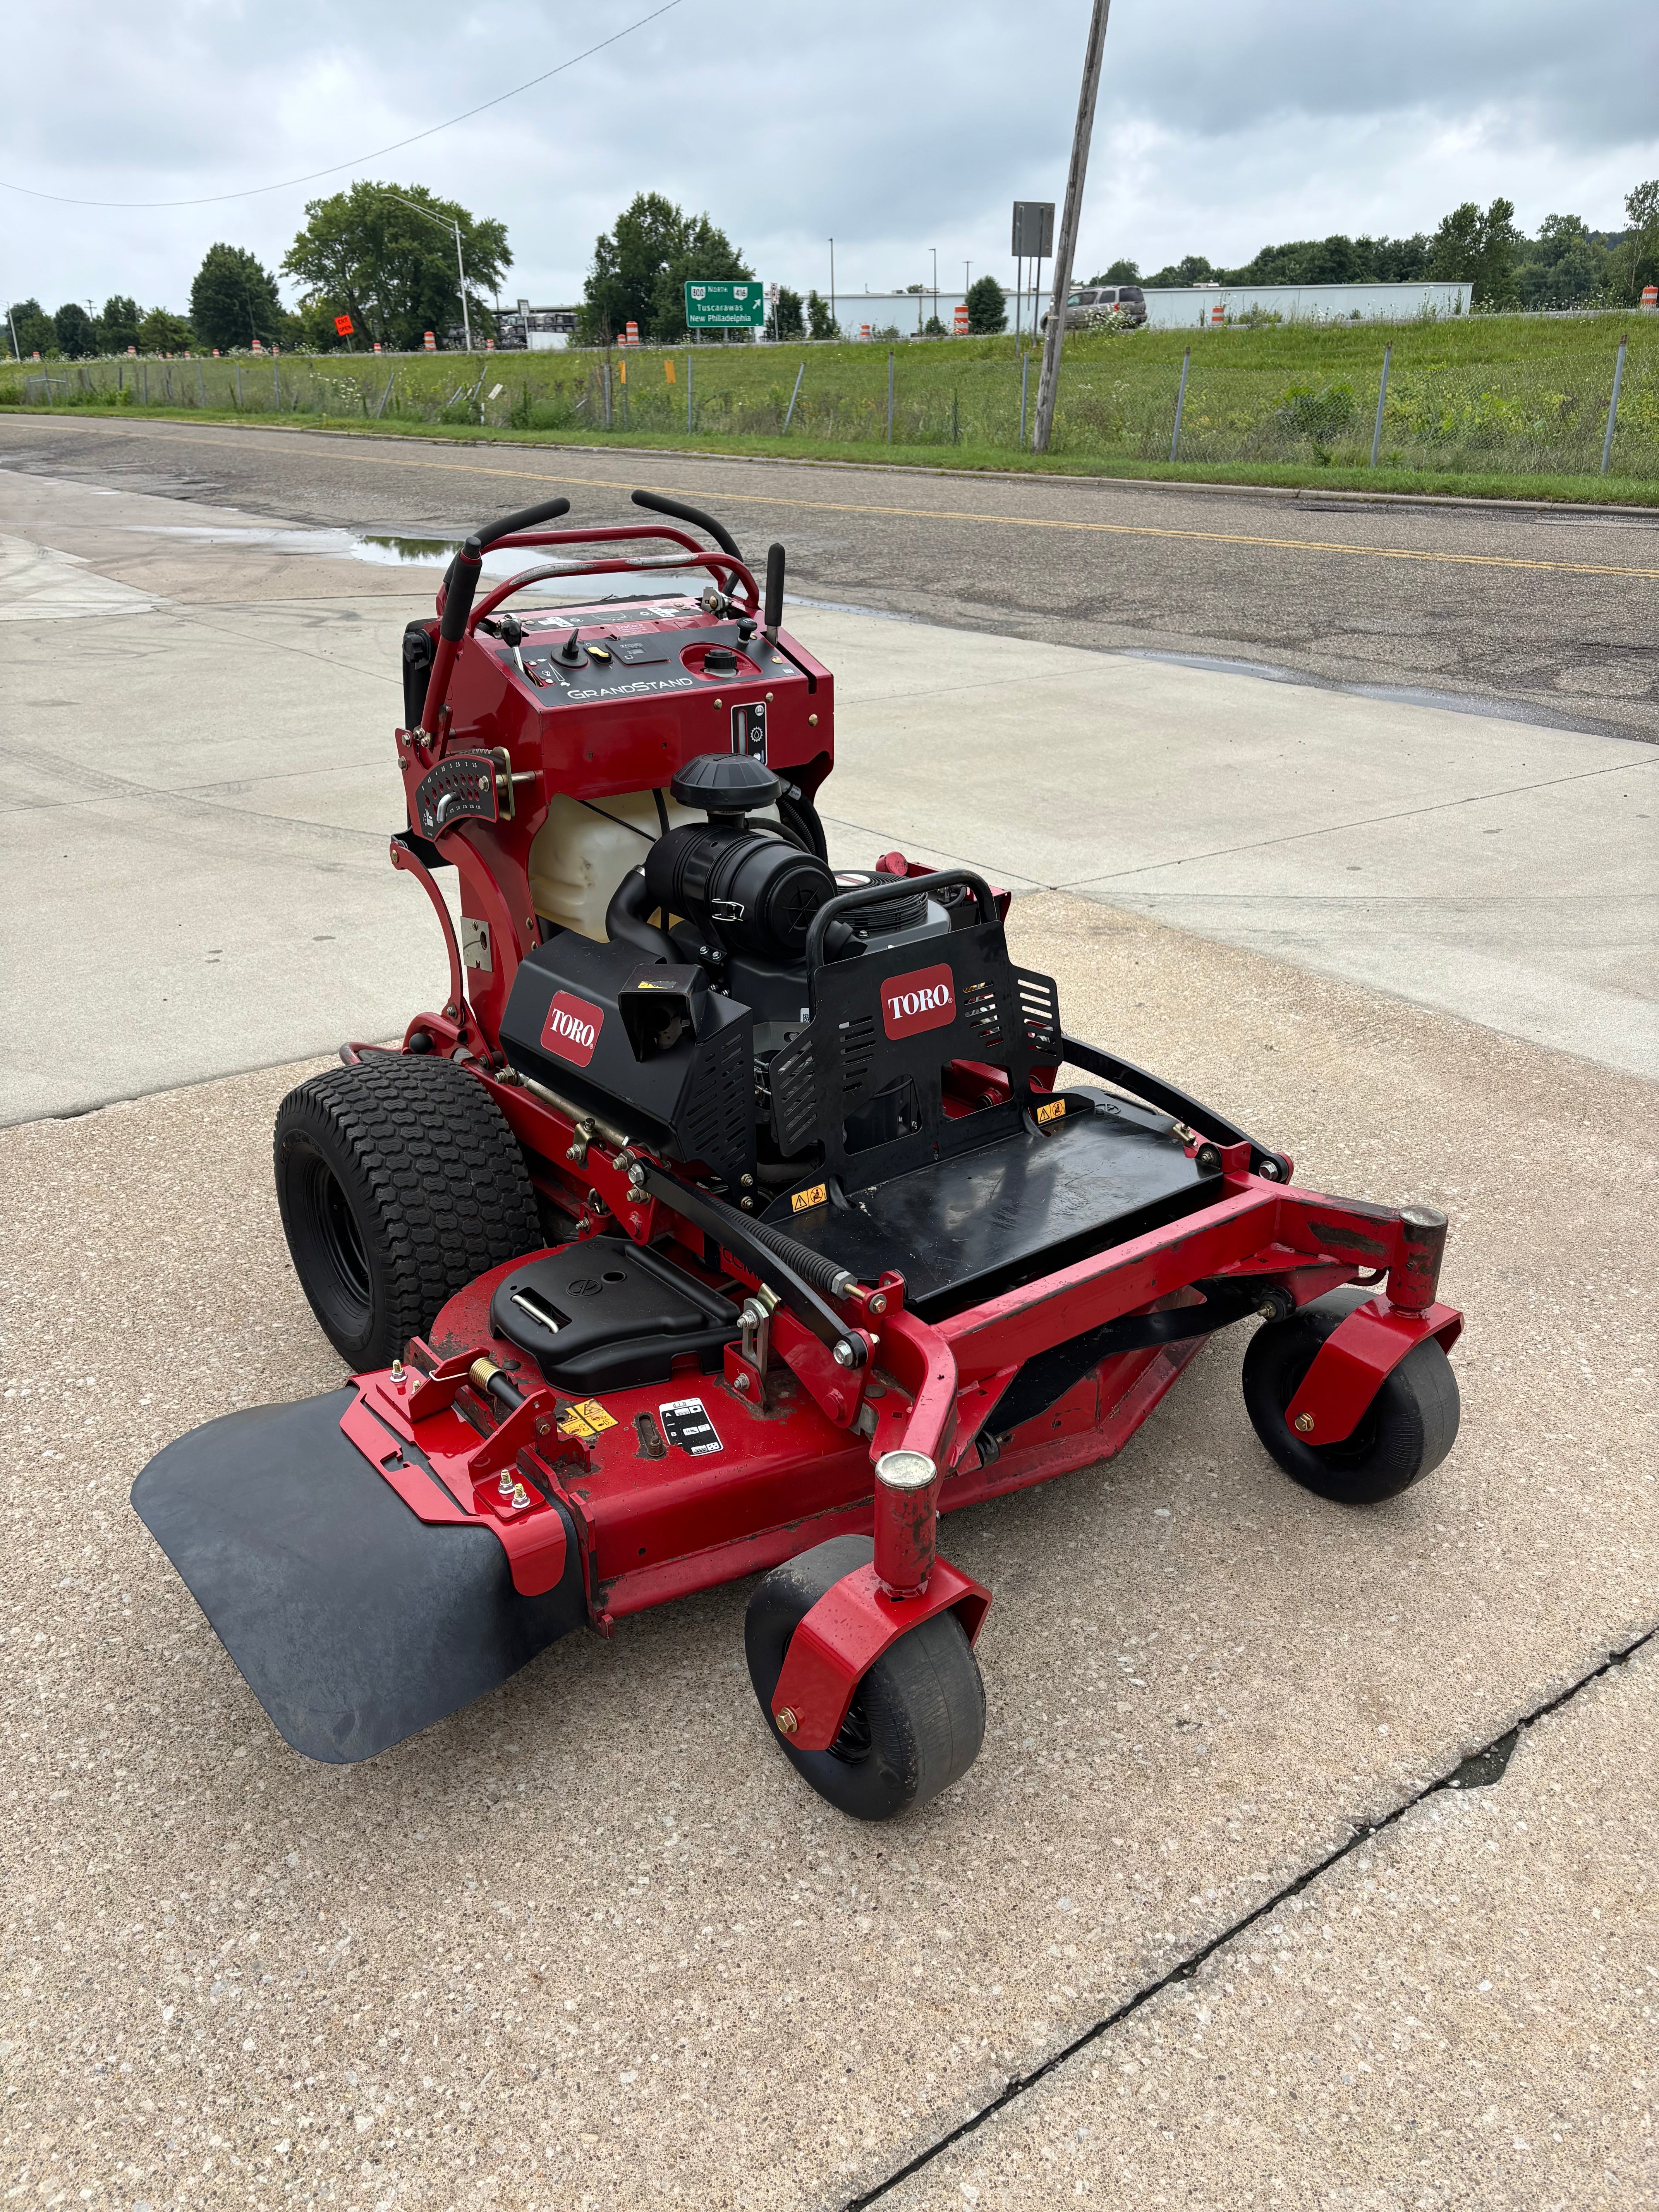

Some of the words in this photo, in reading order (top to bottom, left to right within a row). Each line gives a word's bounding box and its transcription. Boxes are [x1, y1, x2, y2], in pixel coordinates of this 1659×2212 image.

[708, 314, 751, 323] Philadelphia
[567, 678, 693, 699] GRANDSTAND
[888, 984, 949, 1020] TORO
[550, 1008, 594, 1047] TORO
